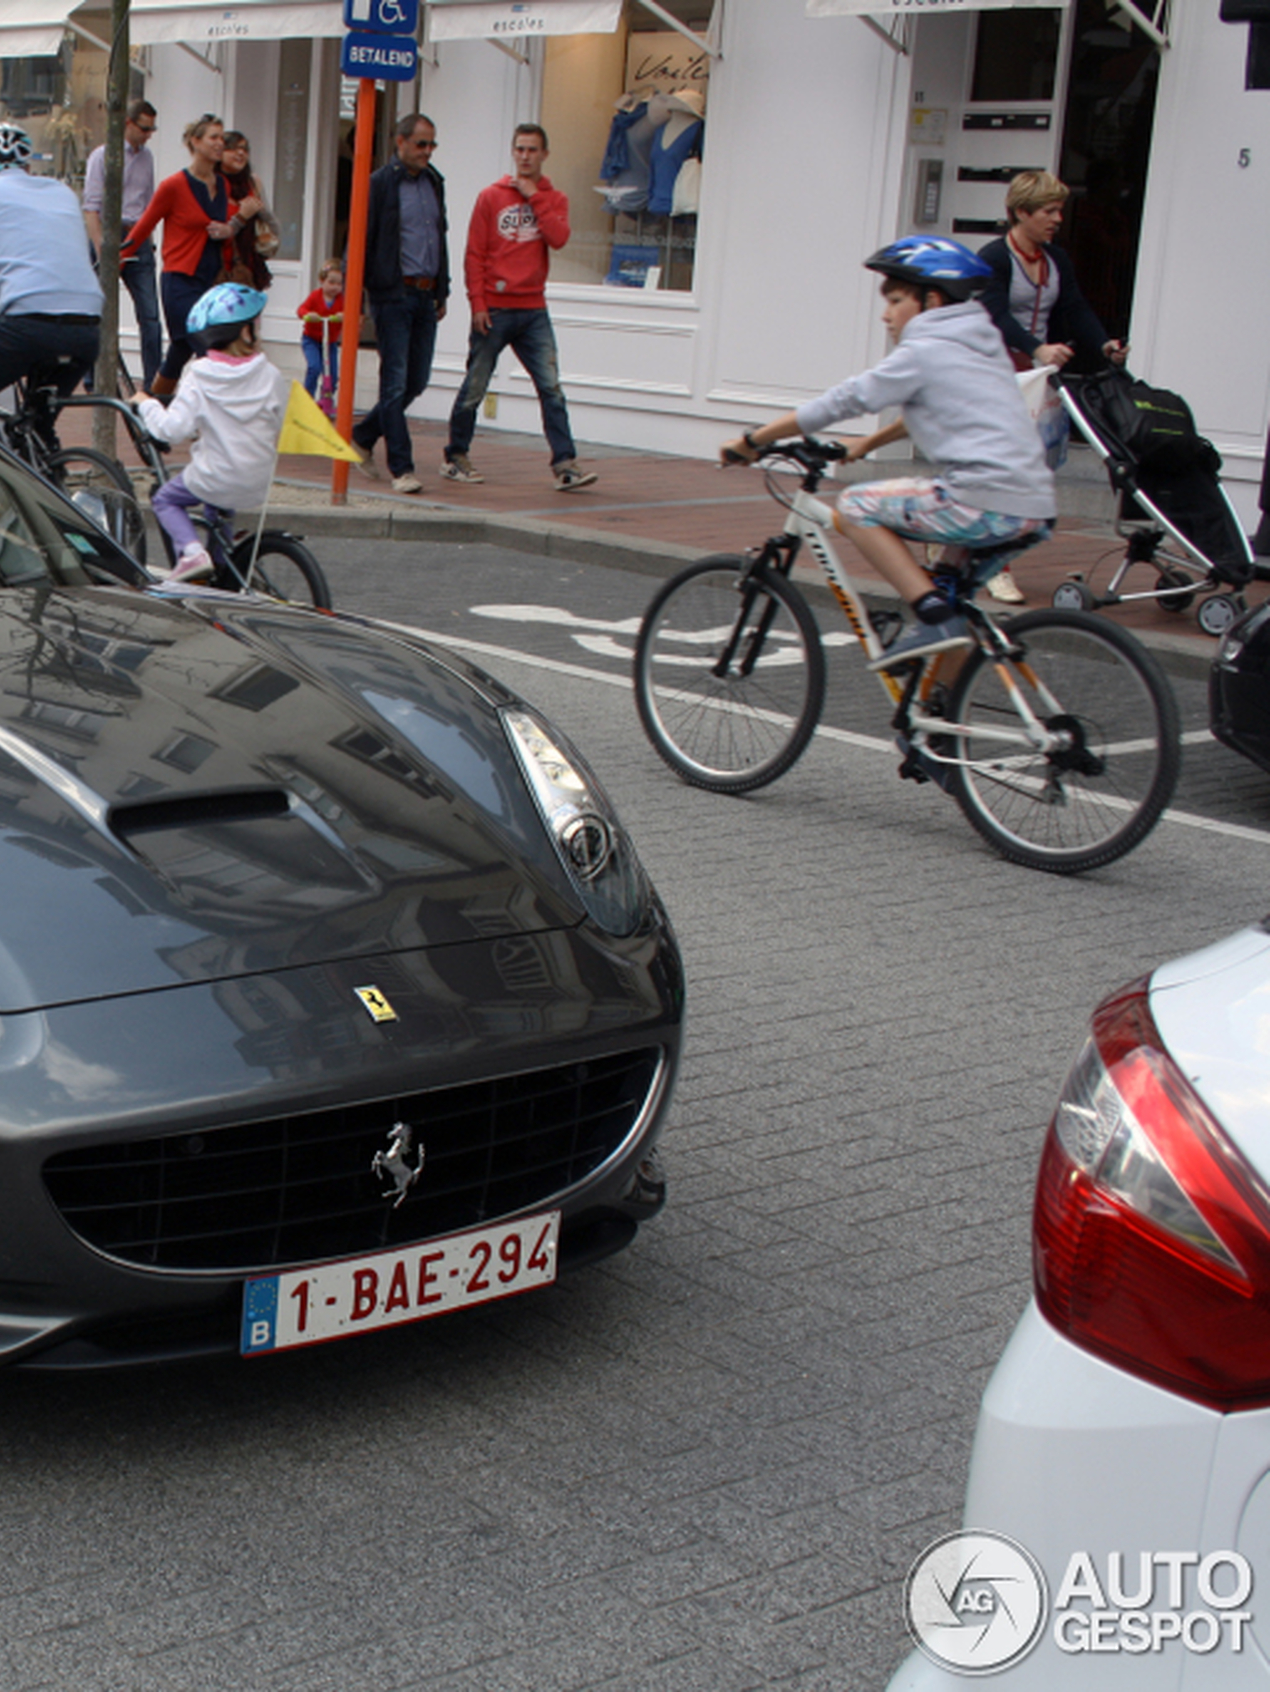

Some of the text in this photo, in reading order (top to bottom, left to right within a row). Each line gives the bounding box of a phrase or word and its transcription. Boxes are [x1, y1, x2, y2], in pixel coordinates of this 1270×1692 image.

[350, 46, 415, 68] BETALEND
[1237, 148, 1250, 169] 5
[290, 1222, 552, 1333] 1-BAE-294
[250, 1320, 270, 1346] B
